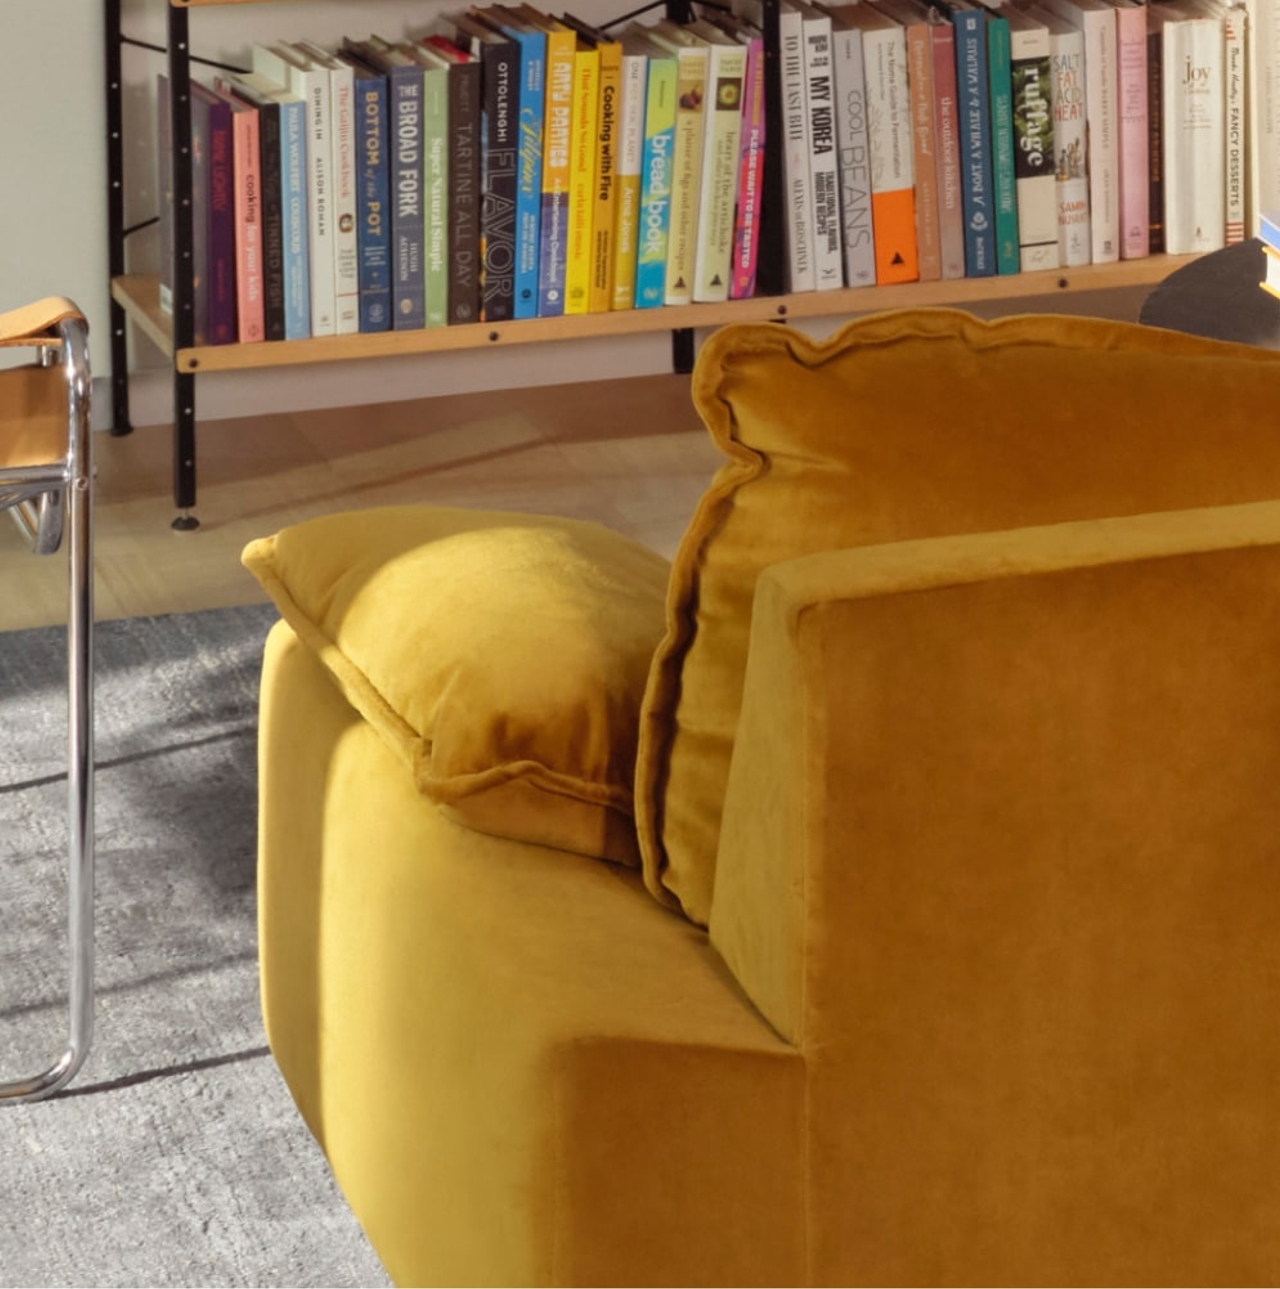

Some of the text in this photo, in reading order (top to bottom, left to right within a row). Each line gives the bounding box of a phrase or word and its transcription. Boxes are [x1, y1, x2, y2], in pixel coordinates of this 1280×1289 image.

[785, 34, 799, 51] TO
[886, 41, 896, 57] The
[966, 38, 978, 82] WALRUS
[1053, 54, 1081, 72] SALT
[630, 61, 640, 80] ONE
[810, 76, 830, 102] MY
[1057, 71, 1078, 88] FAT
[314, 87, 322, 126] DINING
[497, 61, 508, 143] OTTOLENGHI
[1018, 67, 1049, 166] ruffage
[1054, 103, 1083, 122] HEAT
[1056, 88, 1081, 104] ACID
[365, 91, 379, 165] BOTTOM
[550, 107, 571, 168] PARTIES
[600, 86, 615, 200] Cooking with Fire
[749, 129, 759, 167] PLEASE
[811, 106, 833, 155] KOREA
[970, 110, 981, 149] WHALE
[399, 101, 419, 217] BROAD FORK
[841, 91, 871, 249] COOL BEANS
[890, 122, 902, 179] Fermentation
[941, 96, 957, 209] the outdoor kitchen
[971, 150, 982, 160] A
[1230, 108, 1240, 207] FANCY DESSERTS
[316, 157, 324, 194] ALISON
[646, 134, 671, 253] bread book
[747, 170, 757, 197] WAIT
[244, 174, 257, 223] cooking
[367, 201, 381, 236] POT
[430, 137, 444, 272] Super Natural Simple
[455, 123, 473, 288] TARTINE ALL DAY
[247, 225, 257, 242] for
[484, 148, 515, 304] FLAVOR
[741, 227, 752, 268] TASTED
[247, 276, 259, 301] kids
